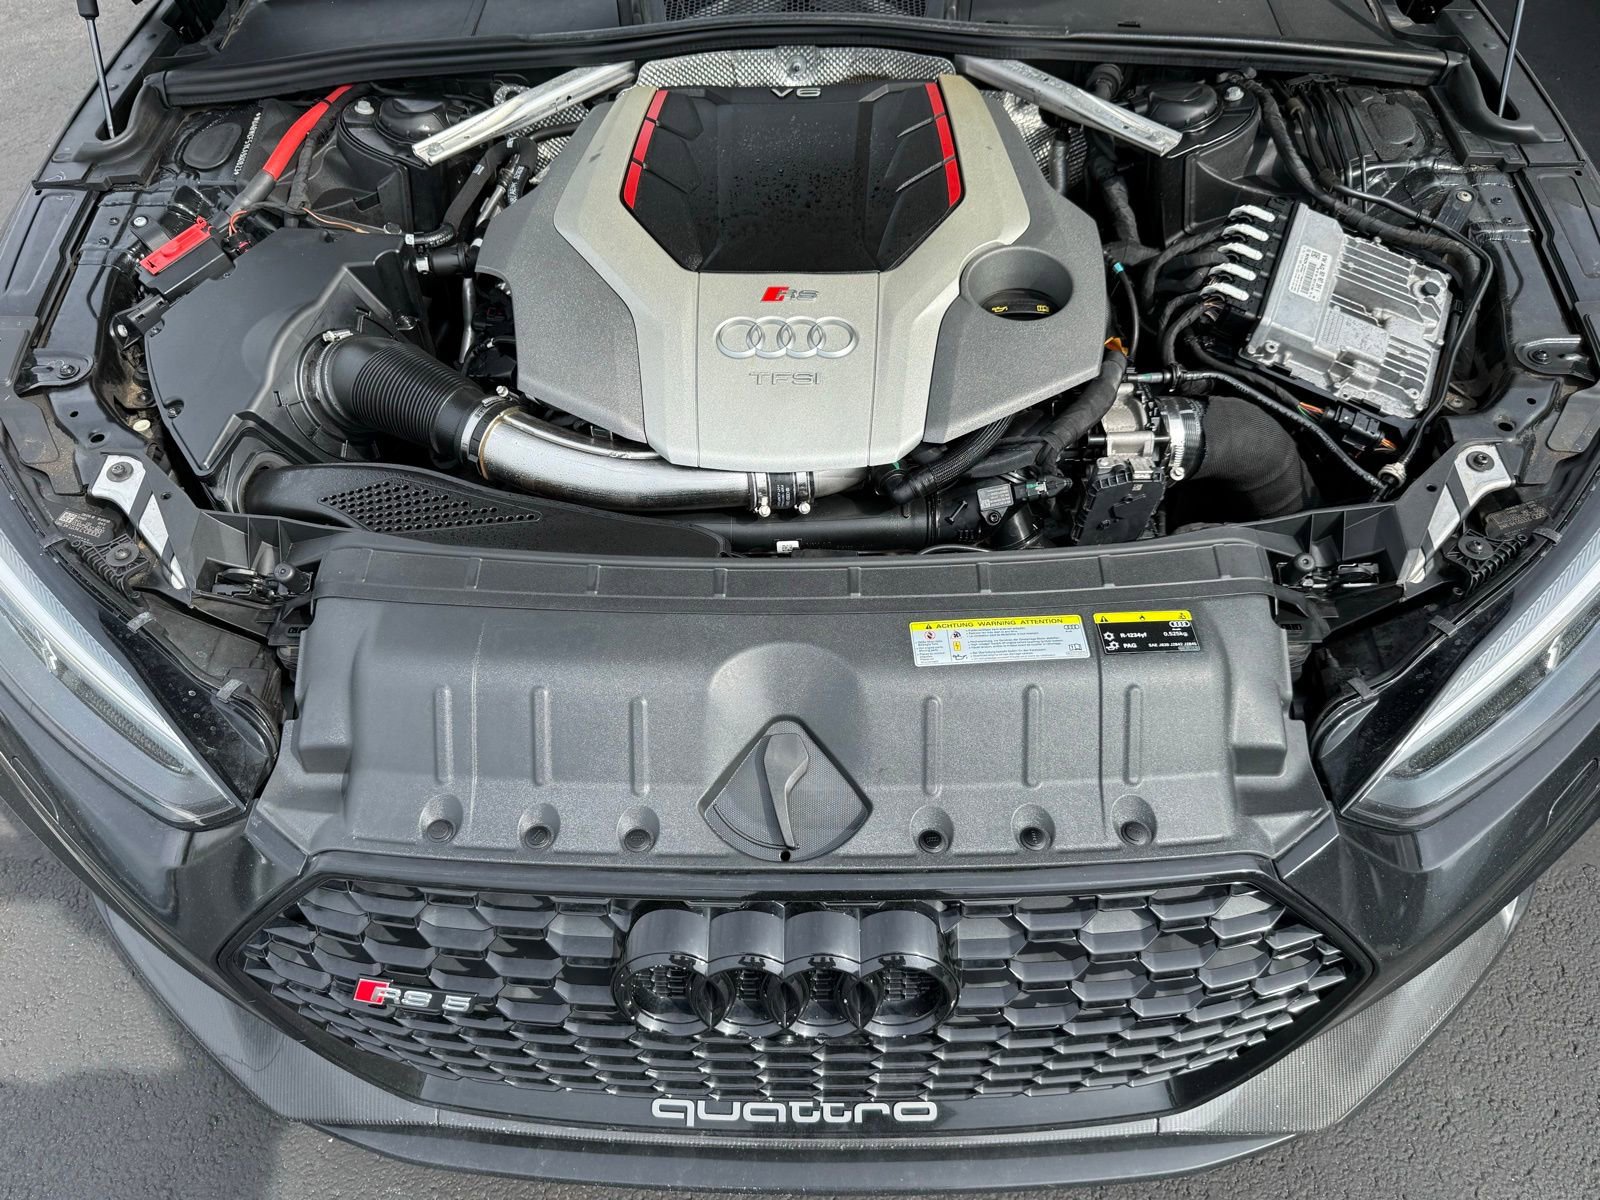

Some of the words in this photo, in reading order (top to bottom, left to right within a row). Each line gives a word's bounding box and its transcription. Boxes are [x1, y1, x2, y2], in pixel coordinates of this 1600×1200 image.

[770, 87, 821, 97] V6
[749, 372, 820, 385] TFSI
[651, 1098, 938, 1127] quattro
